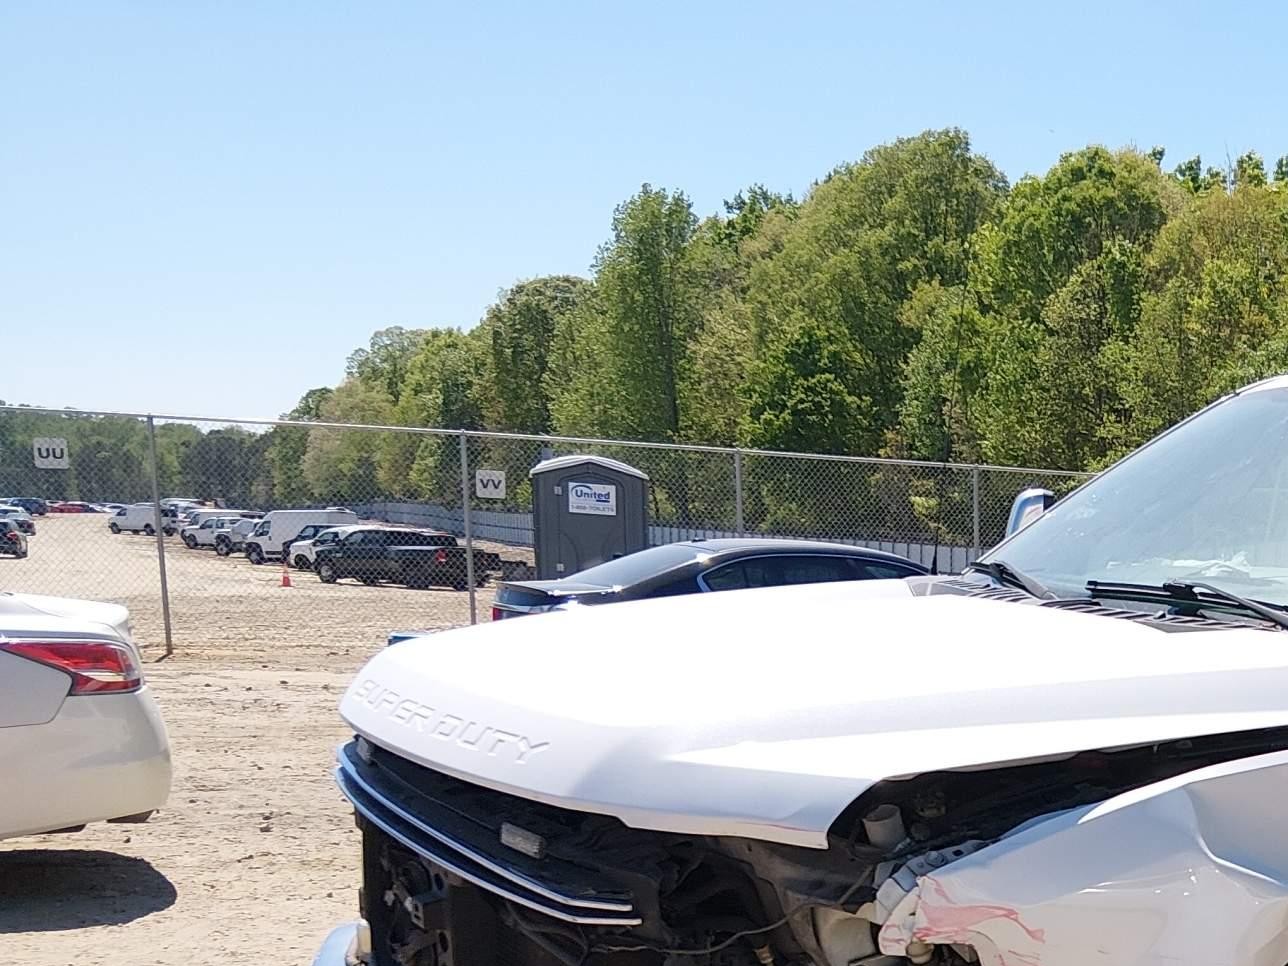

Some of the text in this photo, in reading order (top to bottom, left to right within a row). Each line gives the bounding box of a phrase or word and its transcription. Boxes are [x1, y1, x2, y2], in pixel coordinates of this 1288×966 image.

[37, 447, 64, 459] UU
[480, 478, 502, 489] VV
[575, 489, 611, 500] United
[352, 679, 550, 764] SUPER DUTY
